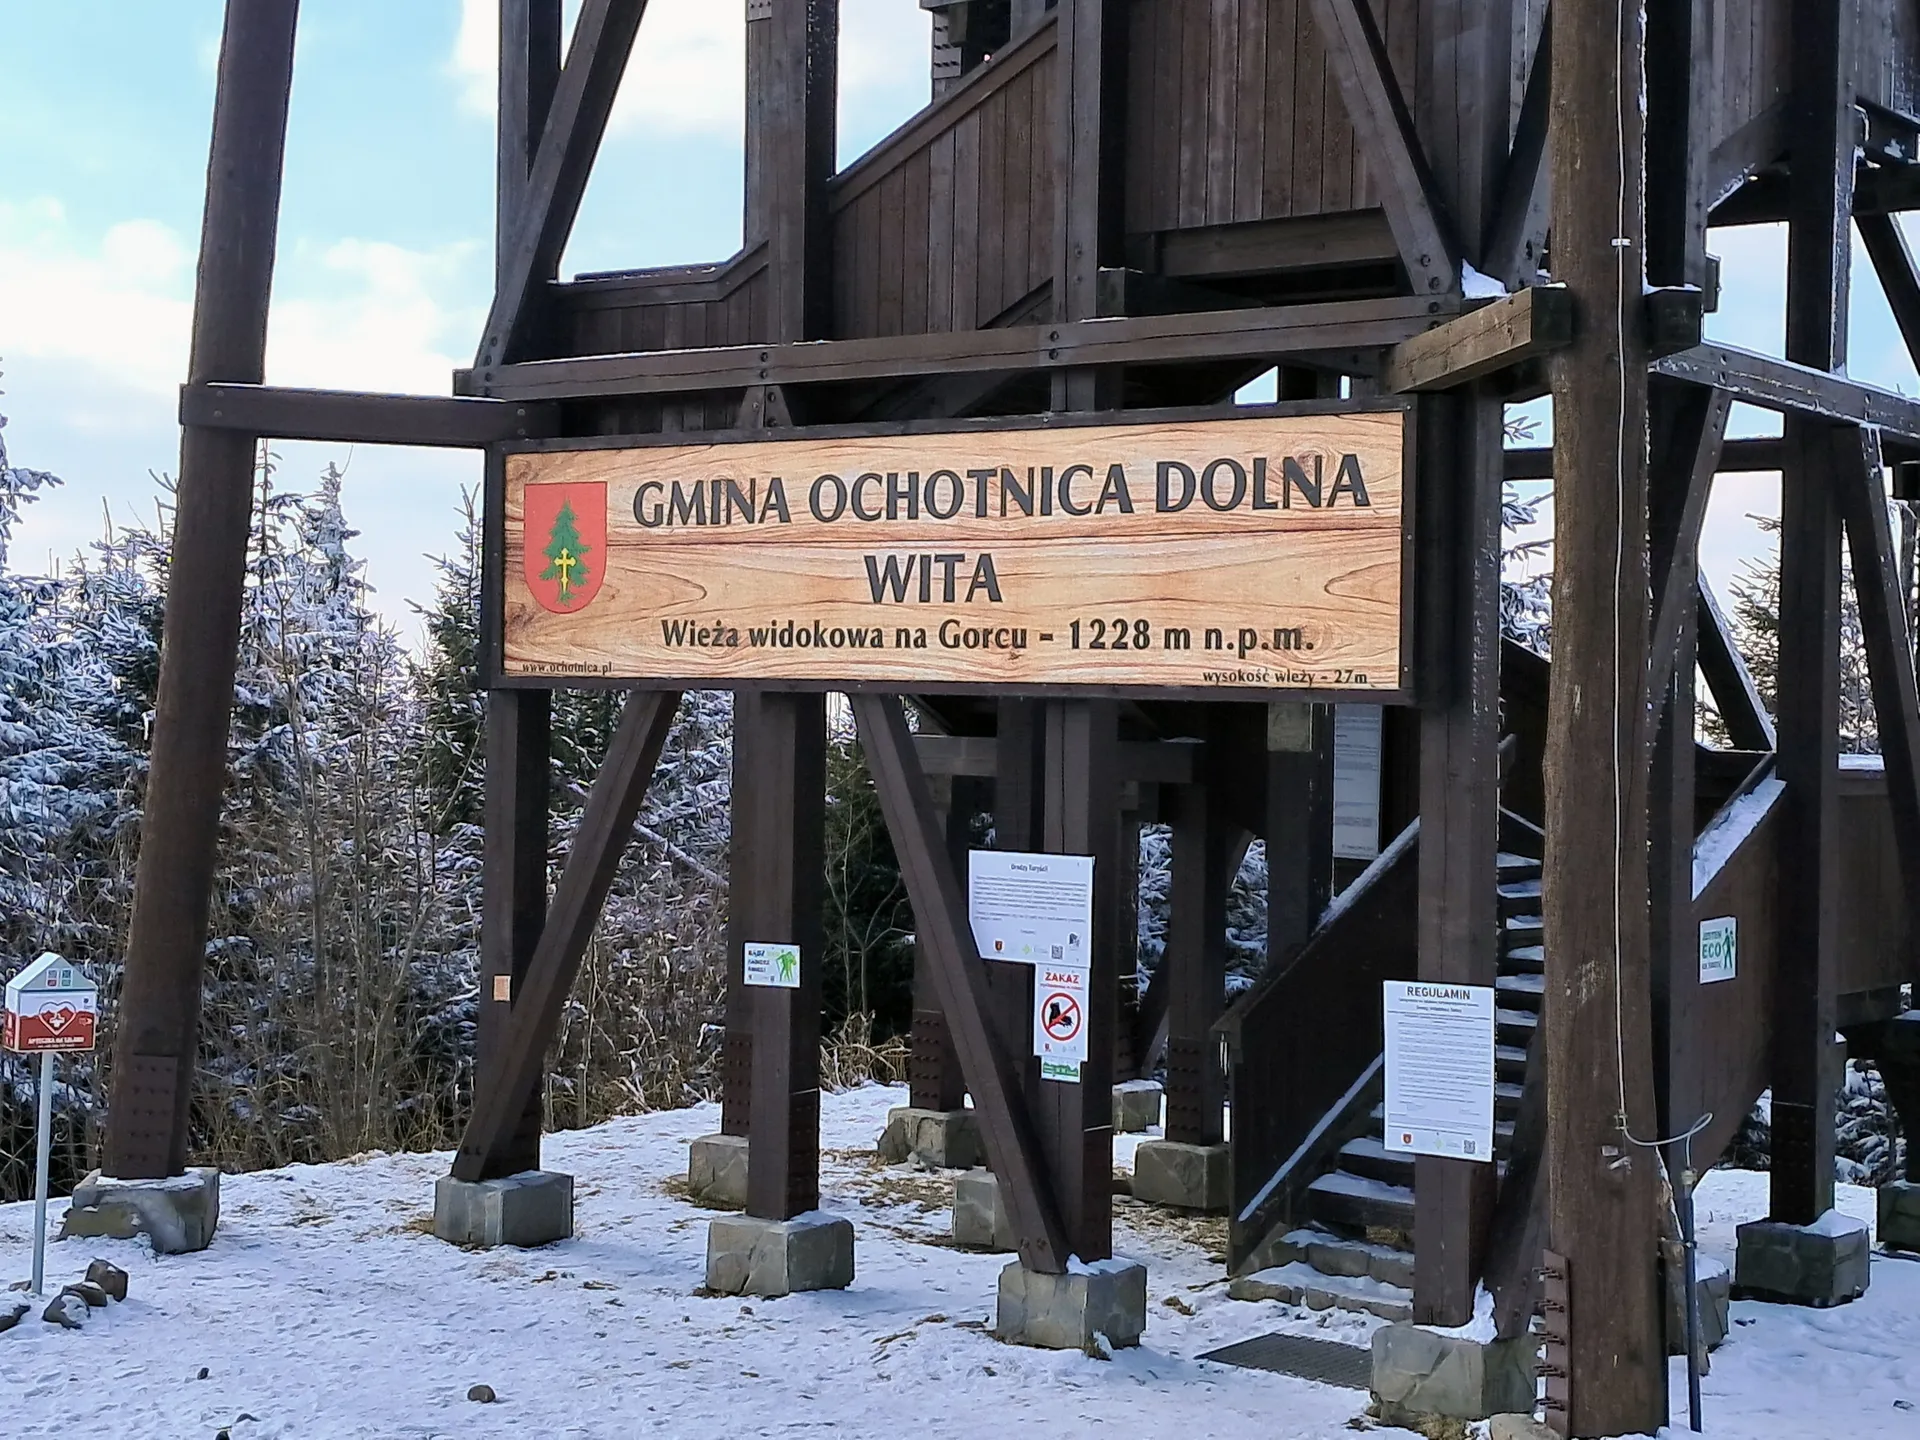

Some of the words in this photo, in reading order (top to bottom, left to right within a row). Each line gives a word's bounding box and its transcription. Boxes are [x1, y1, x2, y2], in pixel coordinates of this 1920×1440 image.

[632, 476, 791, 528] GMINA
[808, 462, 1135, 523] OCHOTNICA
[1154, 453, 1370, 514] DOLNA
[864, 553, 1003, 604] WITA
[661, 618, 739, 649] Wieża
[749, 618, 884, 650] widokowa
[895, 627, 928, 650] na
[938, 618, 1028, 651] Gorcu
[1069, 618, 1151, 651] 1228
[1163, 626, 1191, 651] m
[1203, 626, 1315, 660] n.p.m.
[522, 660, 612, 676] www.ochotnica.pl
[1202, 668, 1270, 686] wysokość
[1275, 668, 1316, 687] wieży
[1702, 942, 1721, 959] ECO
[1044, 971, 1080, 984] ZAKAZ
[1406, 985, 1471, 1000] REGULAMIN
